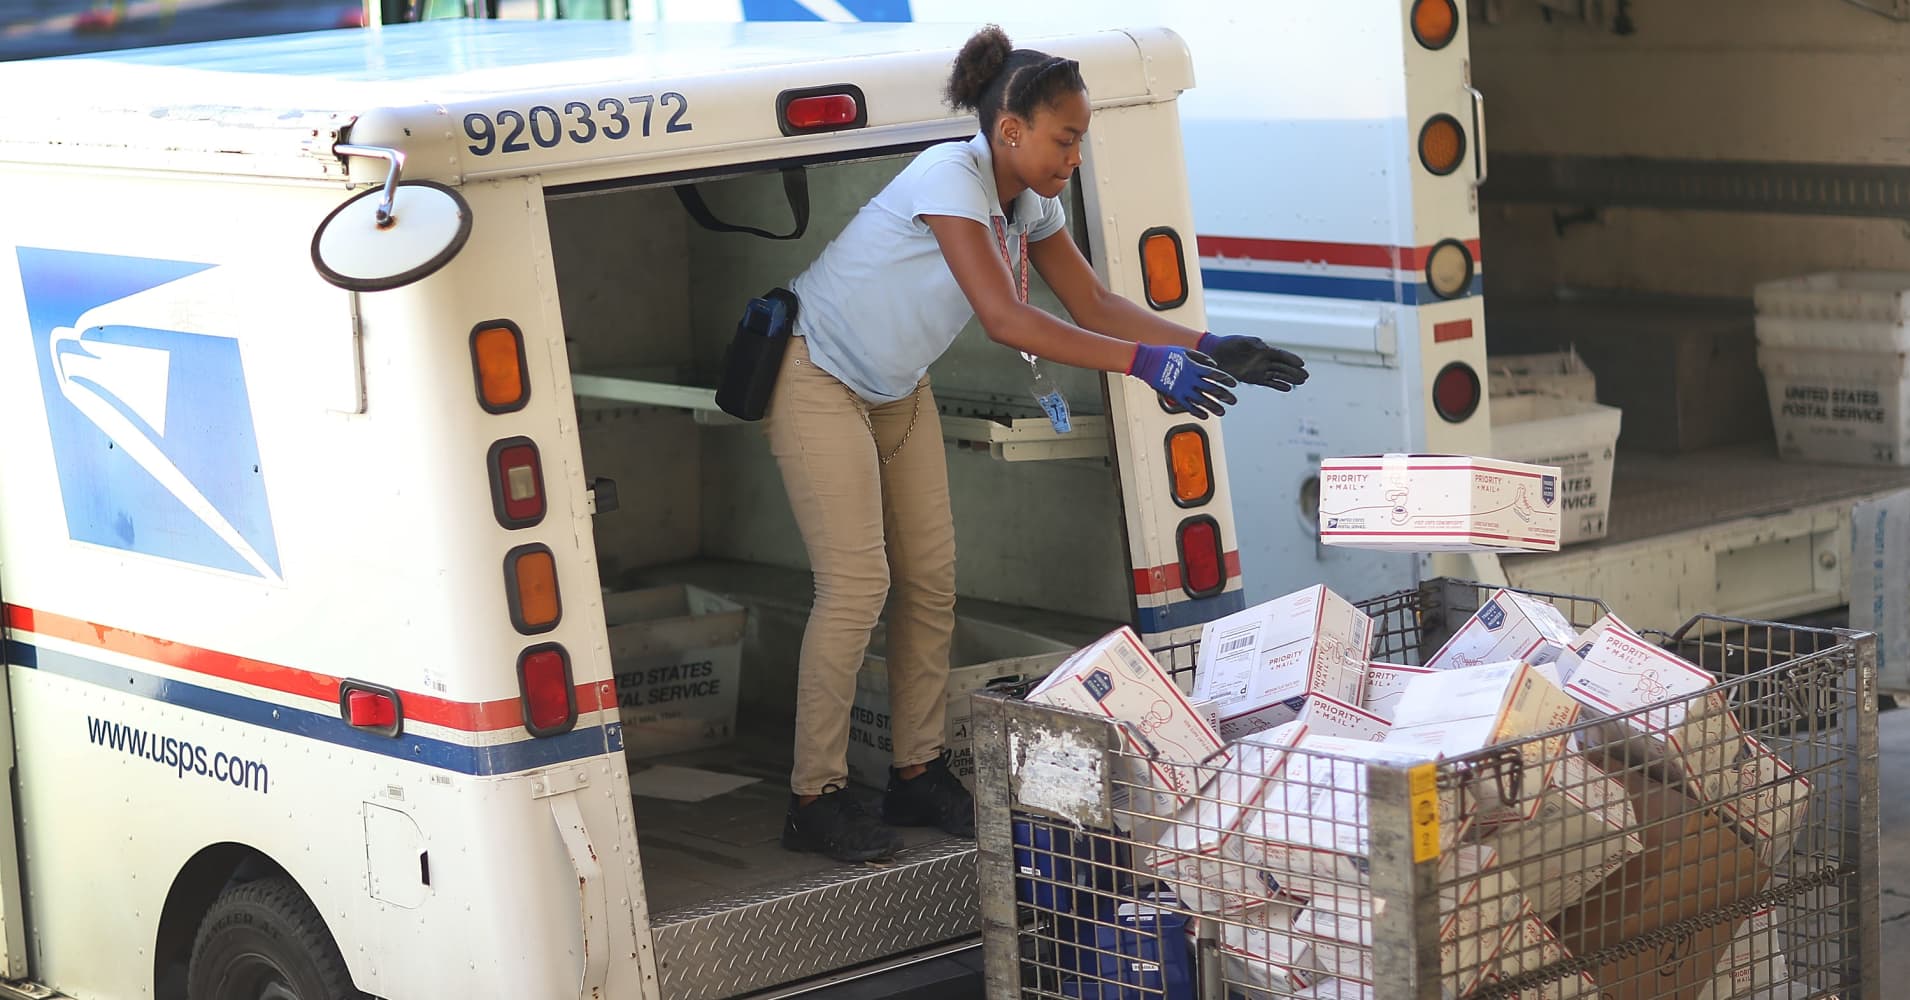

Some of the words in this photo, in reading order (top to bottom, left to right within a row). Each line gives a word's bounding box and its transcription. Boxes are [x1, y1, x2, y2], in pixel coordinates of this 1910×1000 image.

[463, 92, 692, 156] 9203372
[1785, 386, 1829, 403] UNITED
[1832, 388, 1879, 406] STATES
[1781, 403, 1827, 419] POSTAL
[1832, 406, 1885, 424] SERVICE
[1326, 474, 1369, 482] PRIORITY
[1475, 474, 1502, 485] PRIORITY
[1561, 478, 1592, 492] ATES
[1481, 484, 1497, 493] MAIL
[1269, 649, 1303, 665] PRIORITY
[1606, 636, 1650, 662] PRIORITY
[1613, 649, 1635, 664] MAIL
[614, 671, 643, 688] TED
[647, 661, 713, 685] STATES
[1276, 661, 1293, 670] MAIL
[1320, 665, 1329, 687] MAIL
[1368, 672, 1397, 680] ORITY
[647, 680, 721, 705] SERVICE
[1314, 700, 1361, 724] PRIORITY
[1322, 713, 1348, 727] MAIL
[88, 715, 268, 793] www.usps.com
